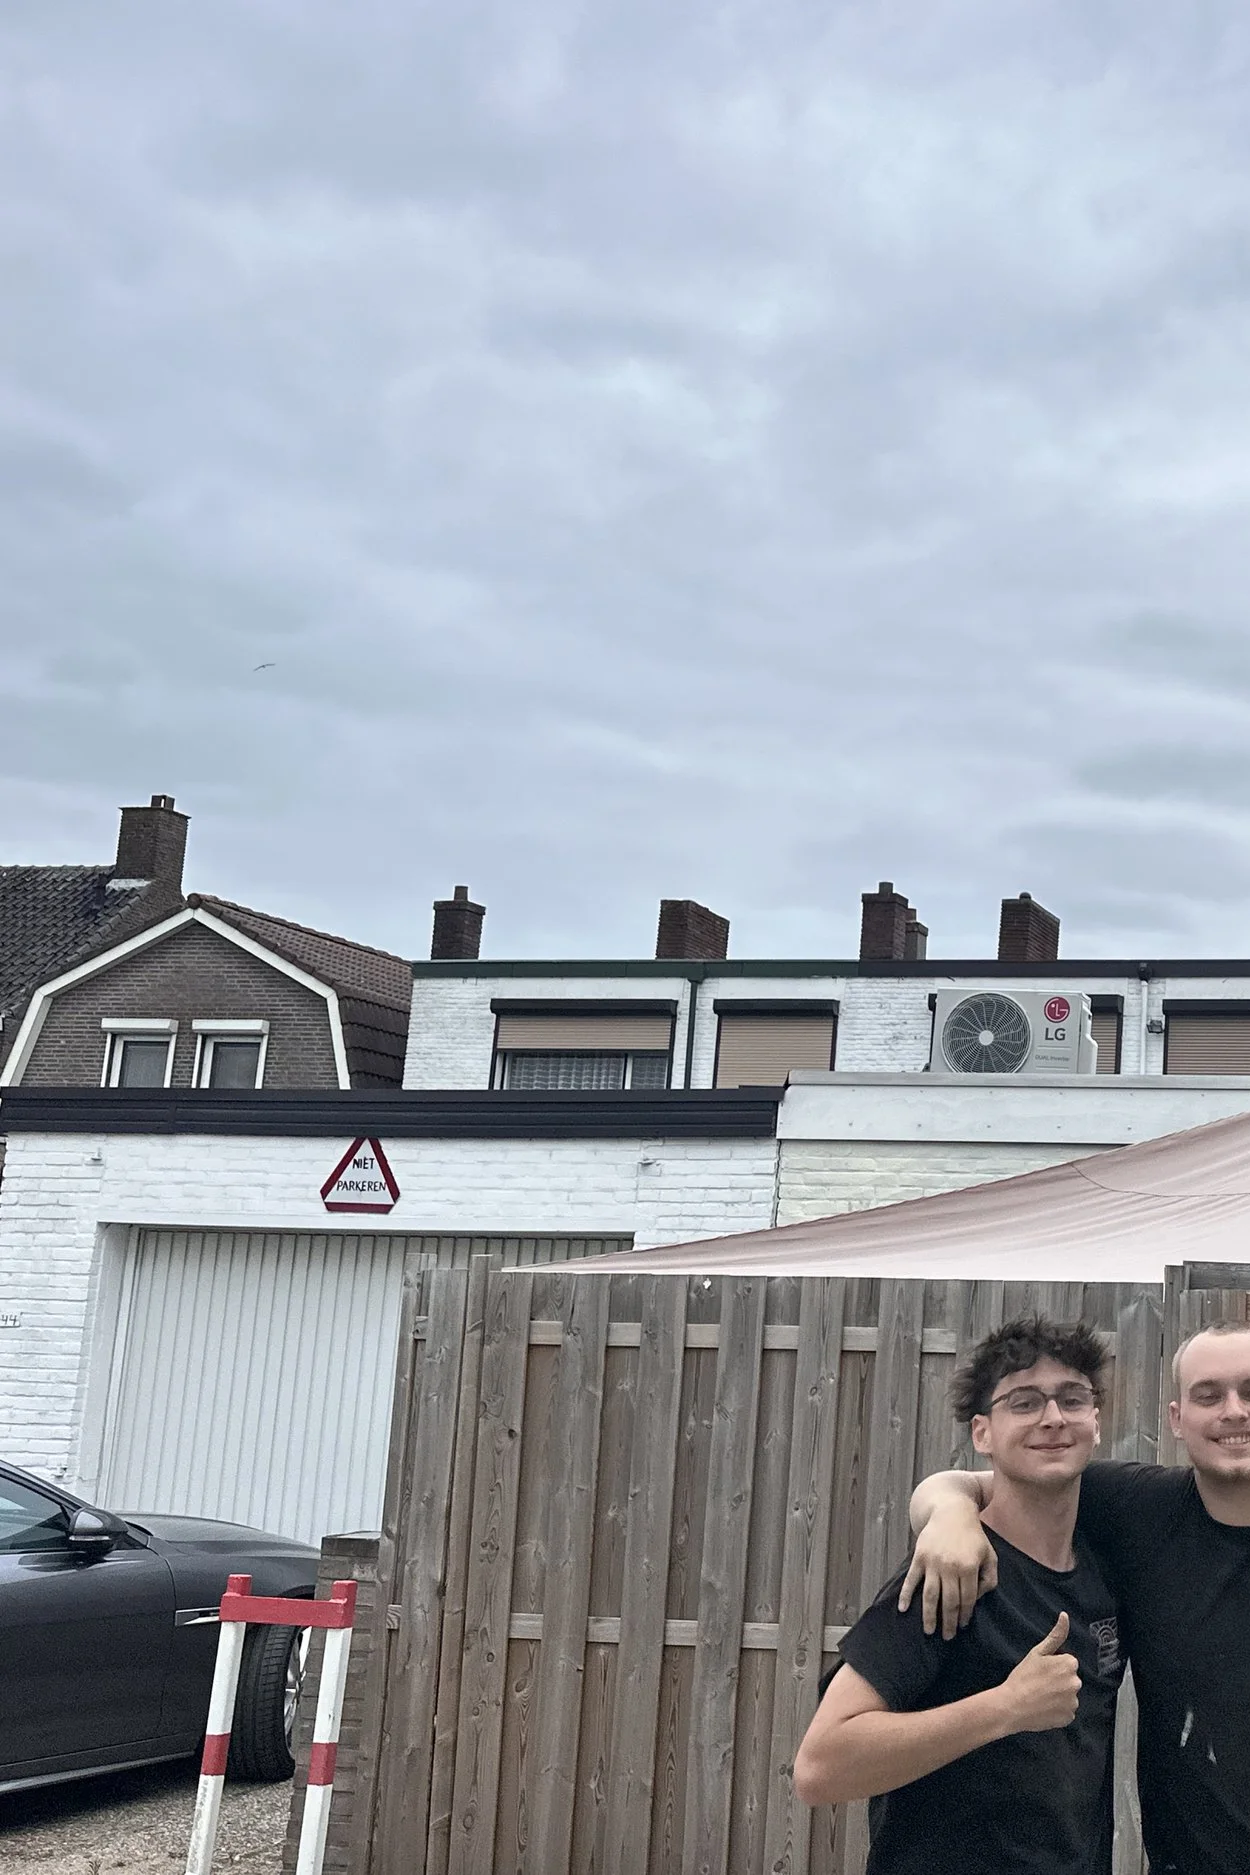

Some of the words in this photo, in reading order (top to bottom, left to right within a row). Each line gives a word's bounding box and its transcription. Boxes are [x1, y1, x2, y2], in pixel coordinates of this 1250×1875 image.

[1045, 1028, 1066, 1041] LG
[352, 1157, 375, 1169] NIET
[336, 1181, 386, 1192] PARKEREN
